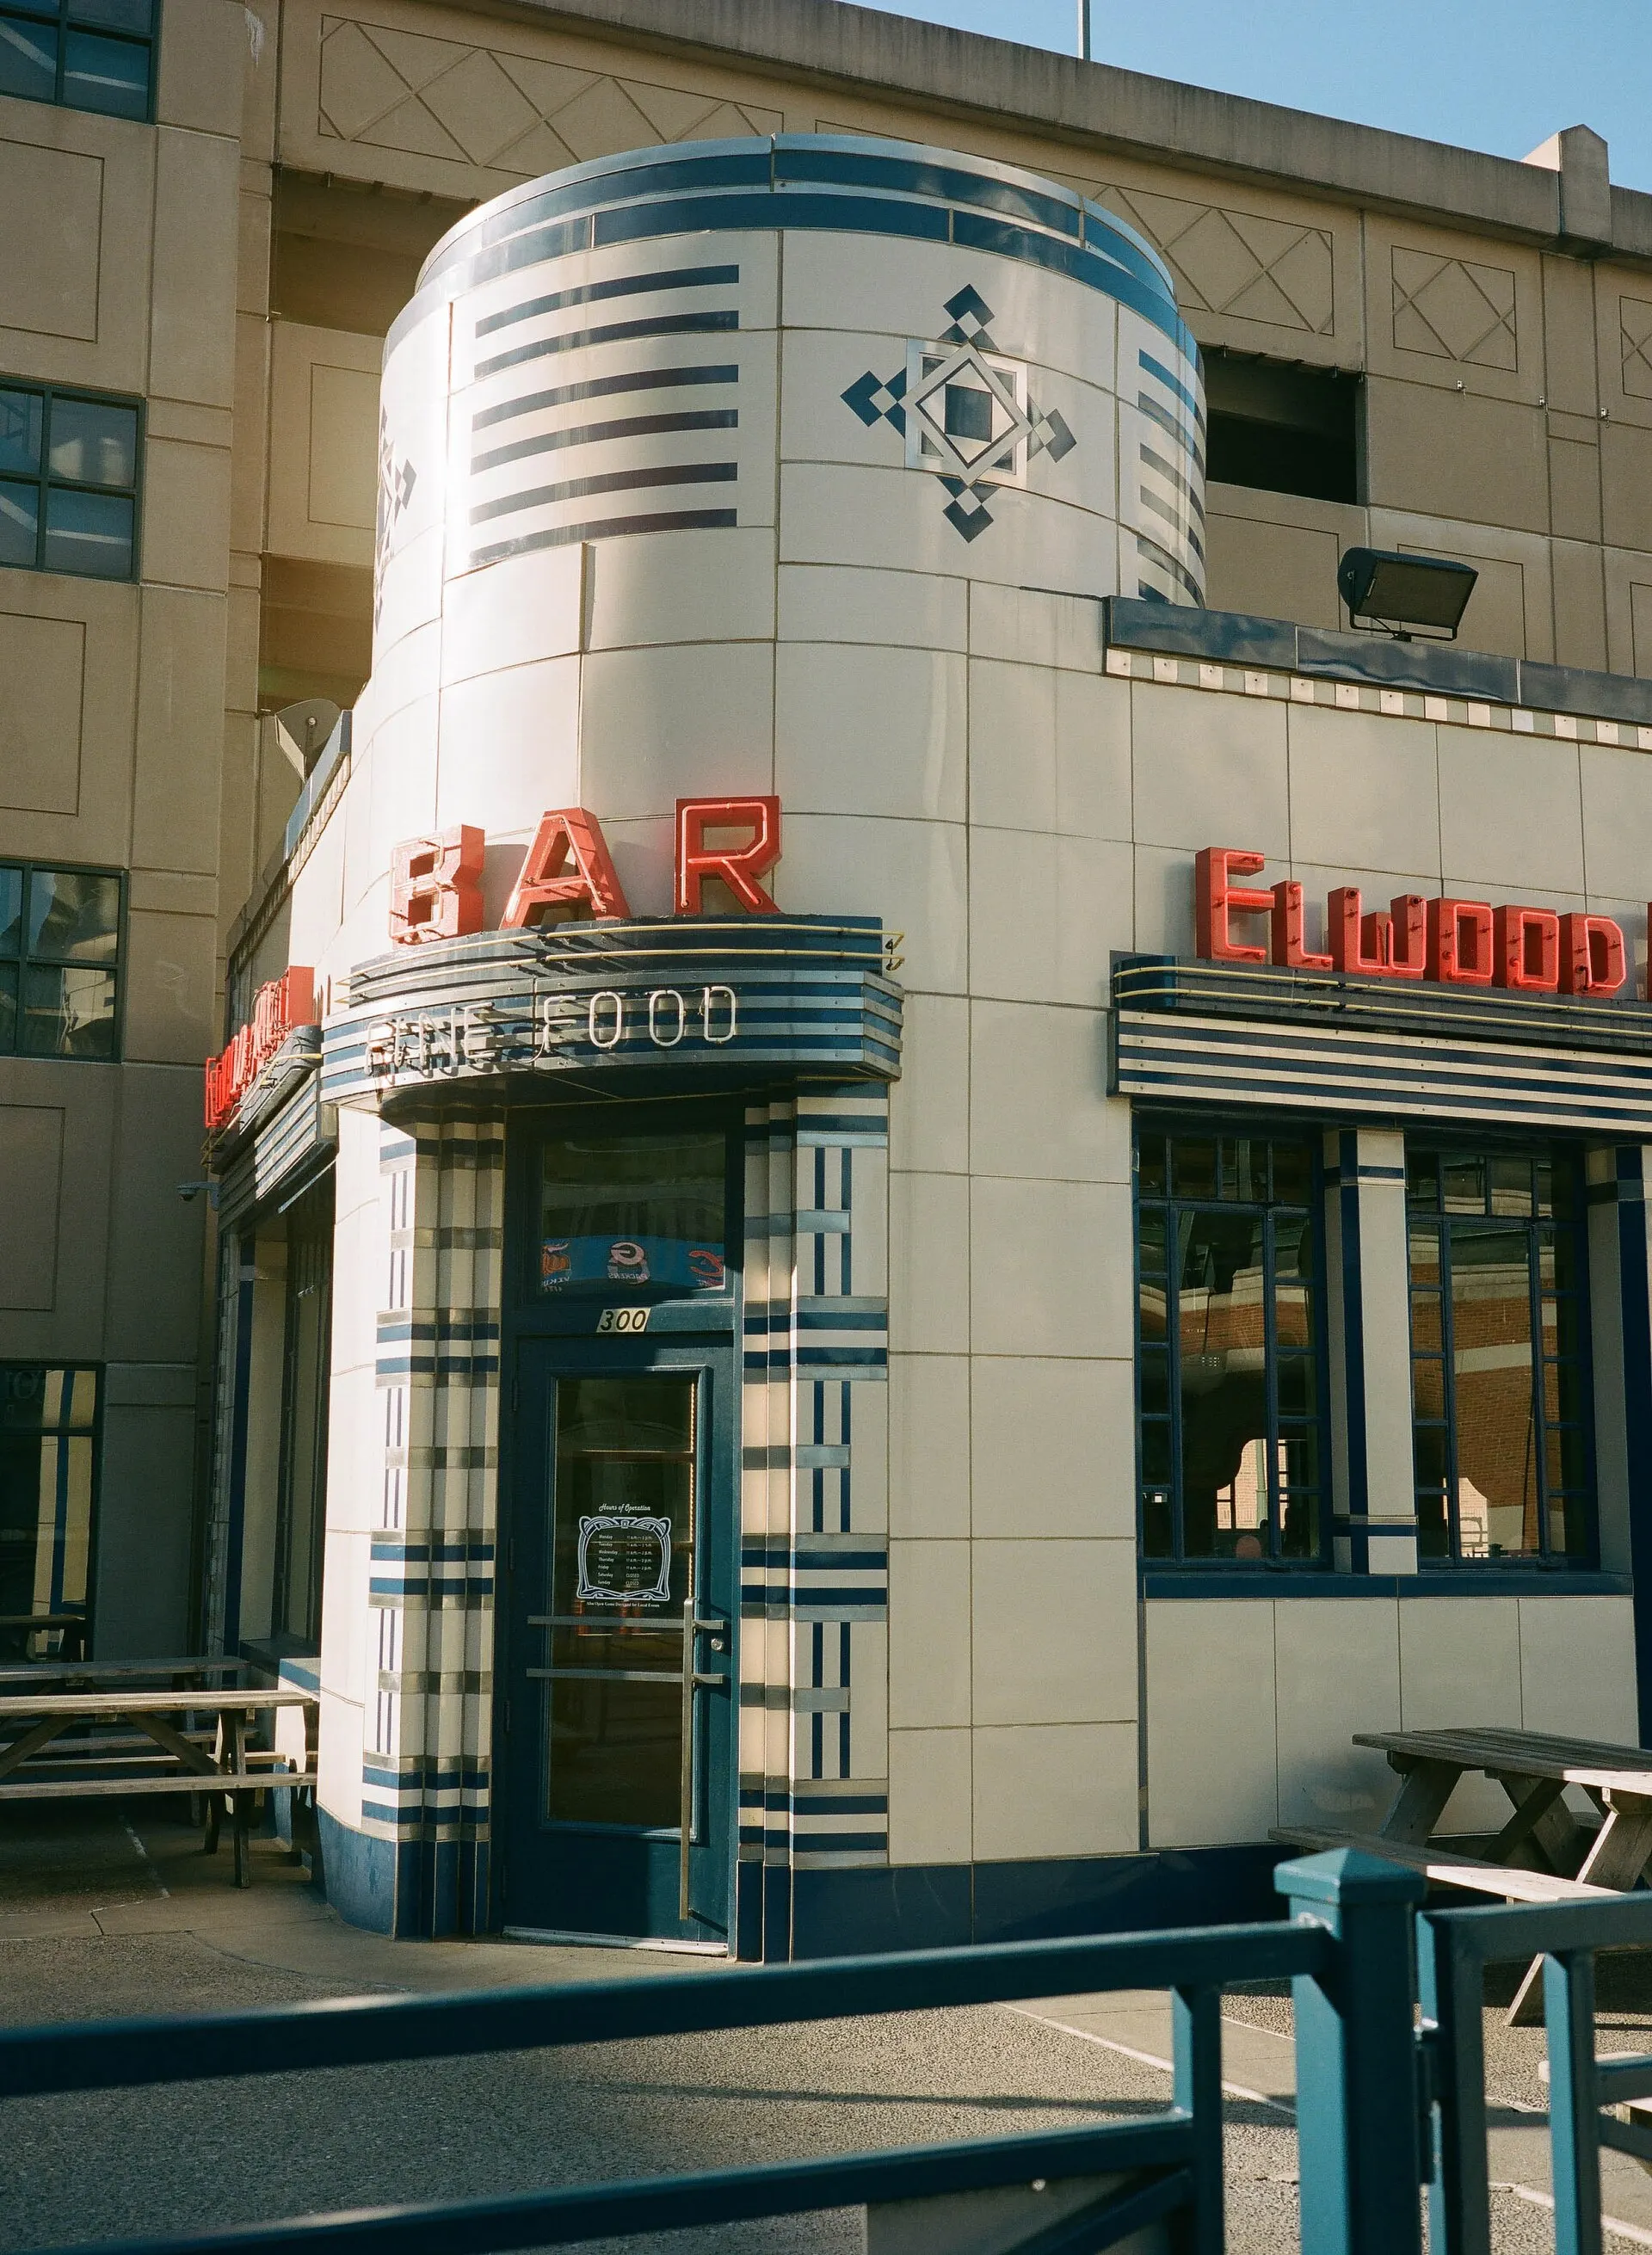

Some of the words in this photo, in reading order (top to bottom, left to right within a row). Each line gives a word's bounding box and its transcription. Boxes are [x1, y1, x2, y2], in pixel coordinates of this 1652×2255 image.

[388, 794, 784, 946] BAR
[1195, 847, 1626, 999] ELWOOD
[364, 1001, 497, 1075] FINE
[544, 986, 737, 1052] FOOD
[600, 1309, 645, 1331] 300
[625, 1503, 650, 1513] Operation
